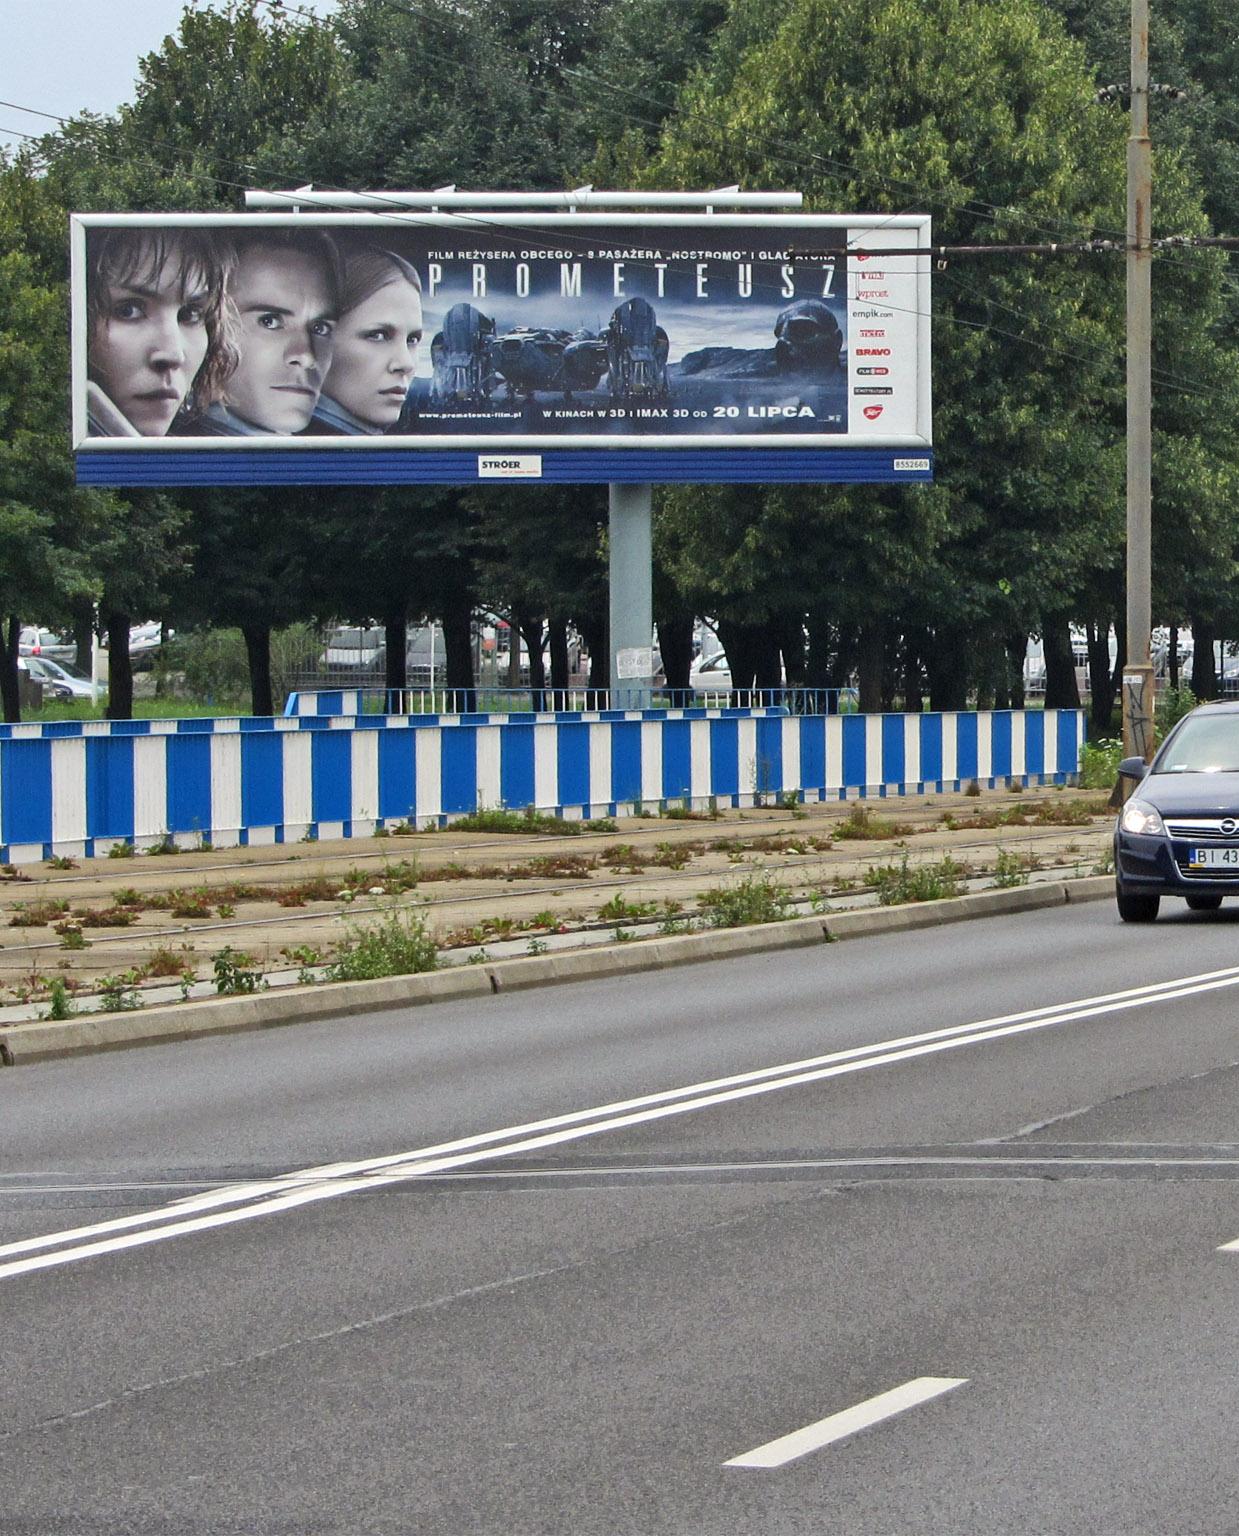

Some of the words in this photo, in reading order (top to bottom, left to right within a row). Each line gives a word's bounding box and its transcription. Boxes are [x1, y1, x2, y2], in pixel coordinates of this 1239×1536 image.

[428, 250, 454, 260] FILM
[458, 249, 516, 260] REŻYSERA
[520, 250, 573, 260] OBCEGO
[599, 249, 662, 260] PASAŻERA
[428, 262, 836, 298] PROMETEUSZ
[852, 308, 893, 319] empik.com
[855, 348, 891, 356] BRAVO
[542, 409, 553, 418] W
[555, 409, 594, 418] KINACH
[597, 409, 607, 418] W
[609, 408, 626, 418] 3D
[636, 408, 669, 418] IMAX
[673, 408, 690, 418] 3D
[692, 410, 708, 418] OD
[713, 406, 740, 418] 20
[747, 405, 816, 418] LIPCA
[1198, 850, 1214, 863] BI
